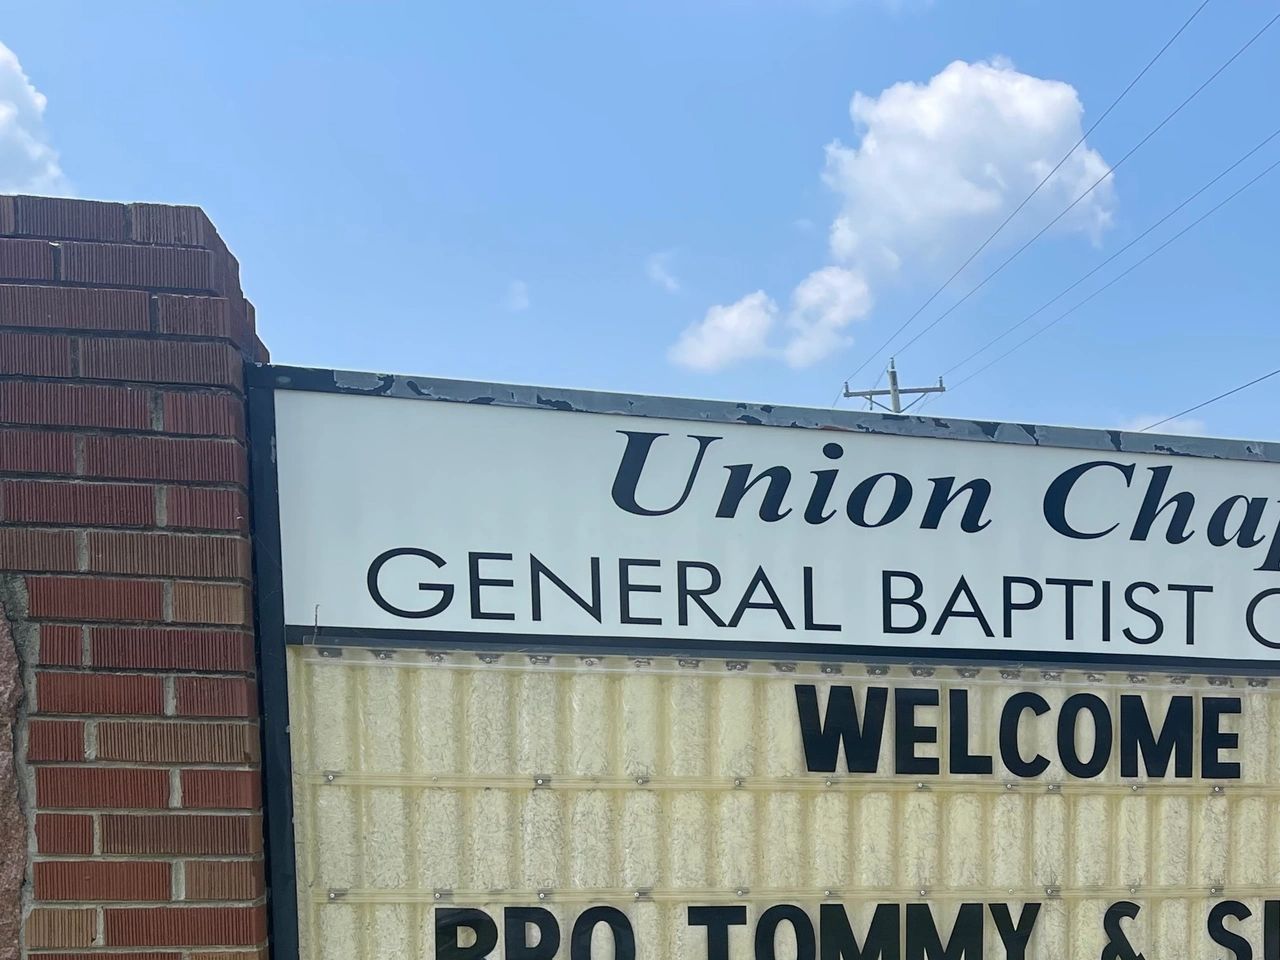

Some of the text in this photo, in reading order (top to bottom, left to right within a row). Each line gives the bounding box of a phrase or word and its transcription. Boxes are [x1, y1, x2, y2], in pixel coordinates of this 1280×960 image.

[612, 431, 992, 533] Union
[367, 548, 841, 631] GENERAL
[882, 571, 1213, 645] BAPTIST
[794, 684, 1241, 779] WELCOME
